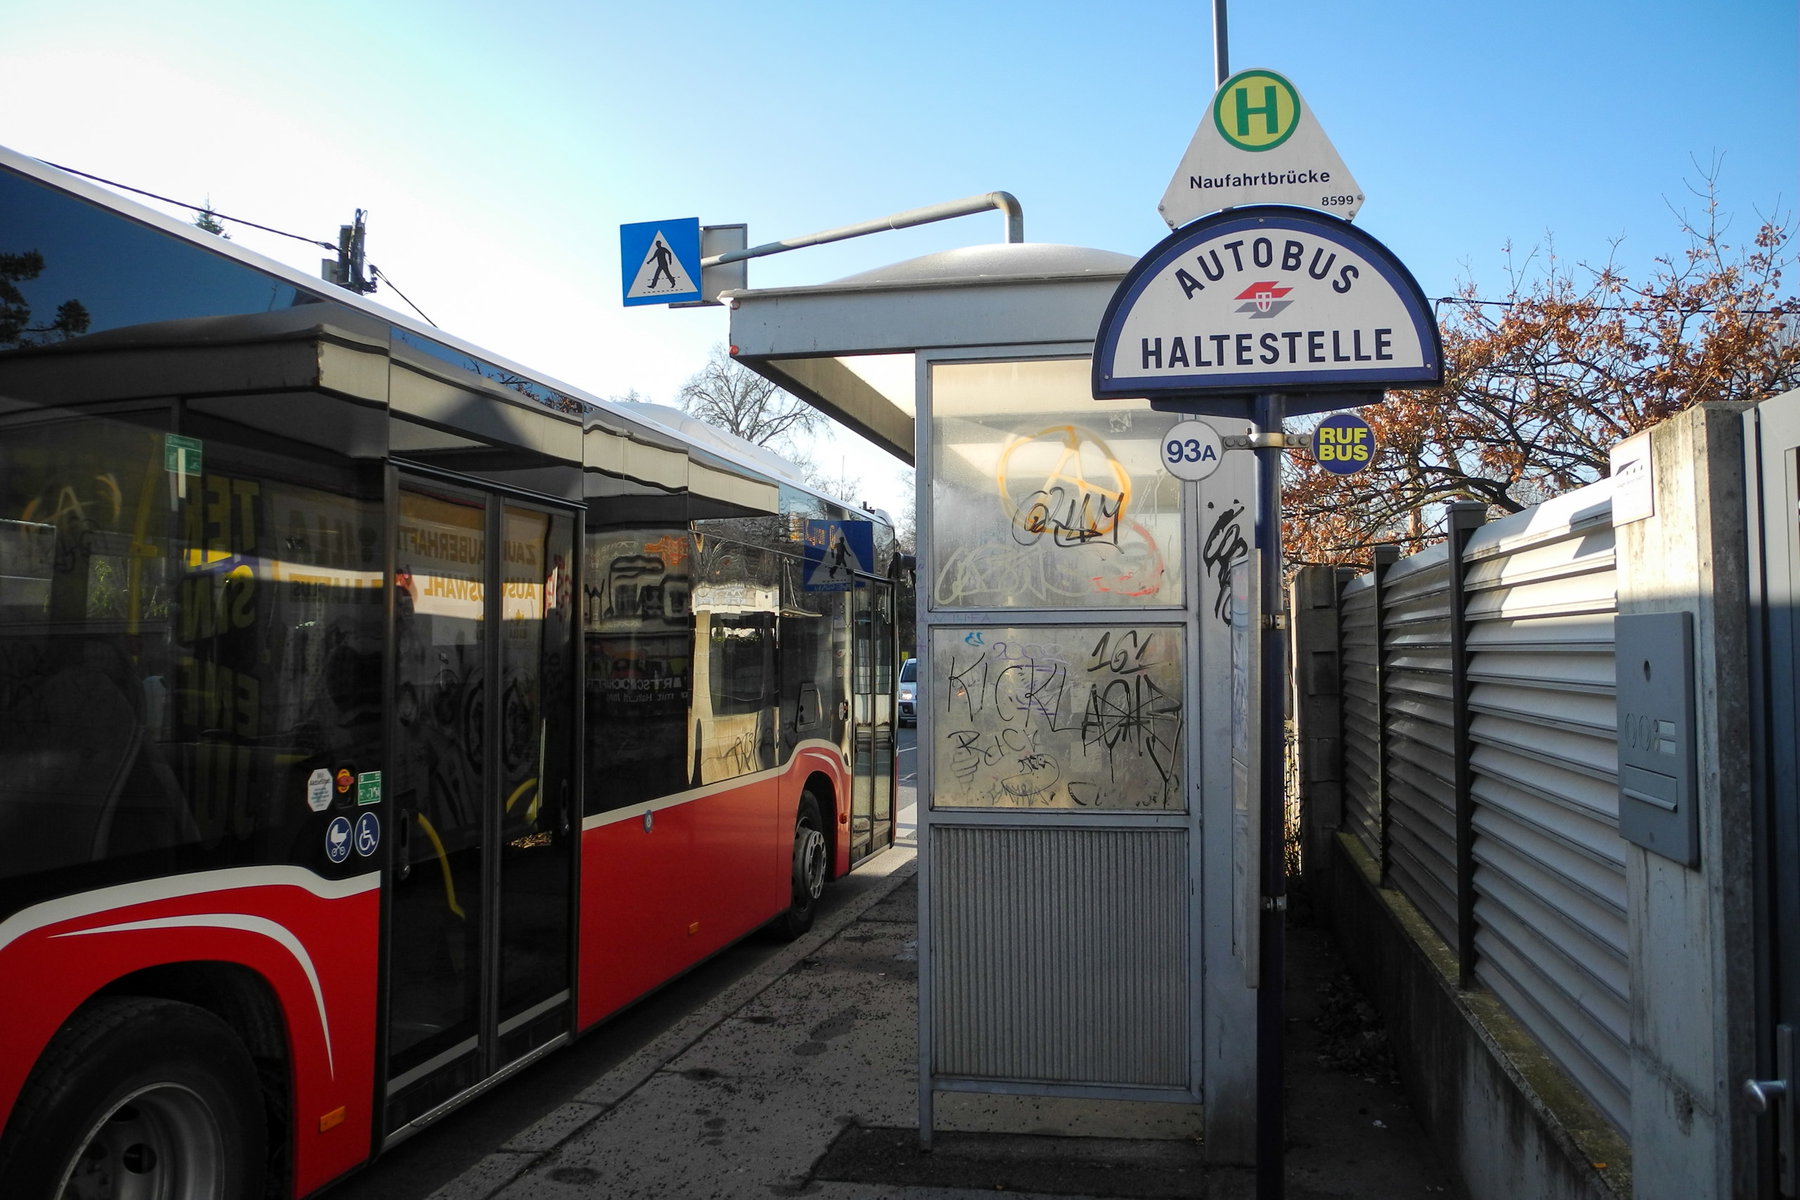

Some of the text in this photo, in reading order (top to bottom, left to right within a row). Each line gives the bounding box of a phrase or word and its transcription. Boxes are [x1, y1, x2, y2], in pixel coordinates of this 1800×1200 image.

[1235, 85, 1279, 137] H
[1189, 170, 1331, 189] Naufahrtbrücke
[1321, 194, 1354, 206] 8599
[1174, 237, 1360, 300] AUTOBUS
[1141, 328, 1394, 370] HALTESTELLE
[1319, 427, 1368, 444] RUF
[1166, 439, 1217, 464] 93A
[1319, 445, 1369, 461] BUS
